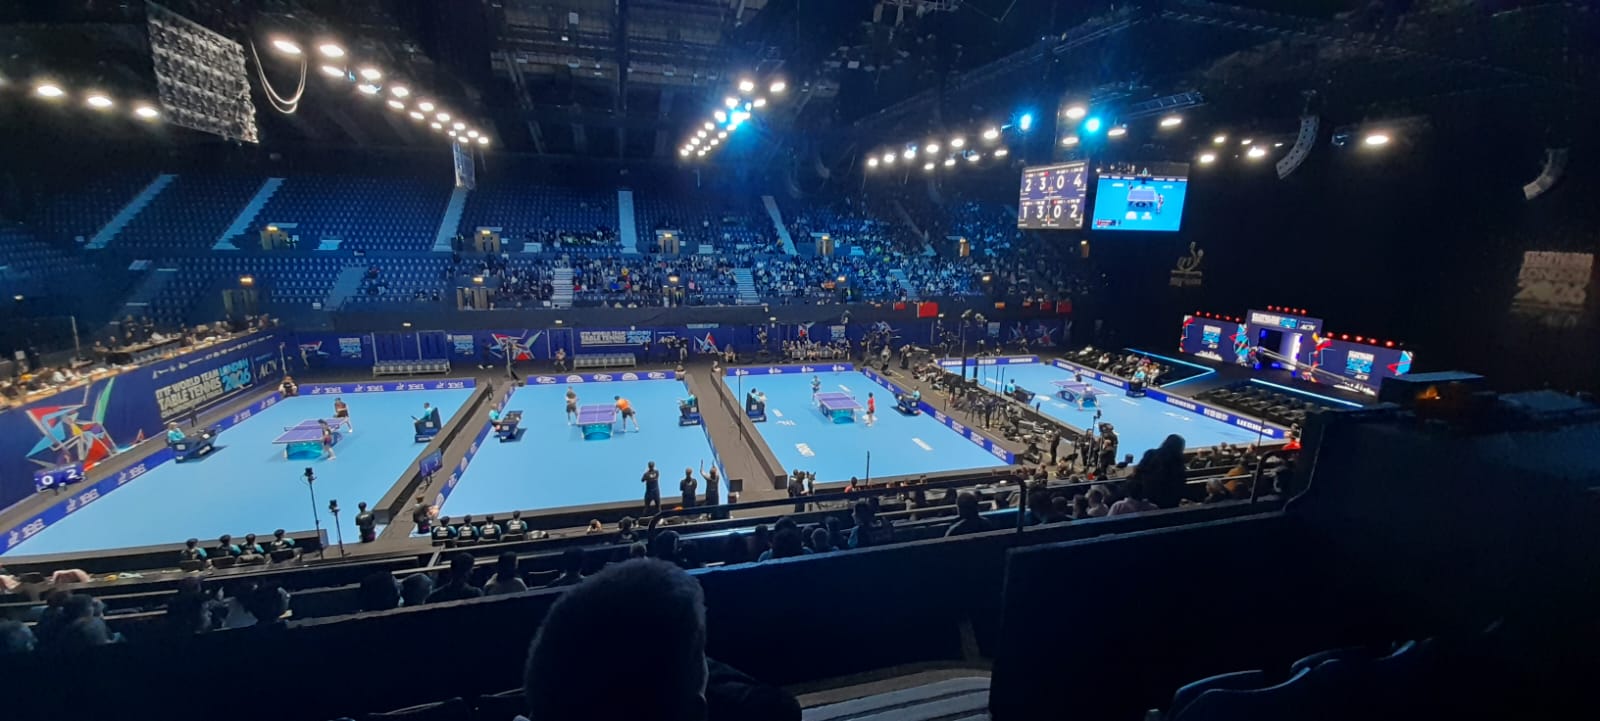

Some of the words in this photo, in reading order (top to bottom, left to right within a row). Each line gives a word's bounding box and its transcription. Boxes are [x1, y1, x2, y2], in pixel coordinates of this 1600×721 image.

[1025, 179, 1031, 192] 2
[1039, 177, 1046, 190] 3
[1057, 175, 1064, 189] 0
[1073, 173, 1082, 187] 4
[1023, 206, 1028, 218] 1
[1037, 205, 1043, 218] 3
[1053, 205, 1061, 218] 0
[1070, 204, 1078, 218] 2
[219, 358, 249, 376] LONDON
[171, 376, 200, 393] WORLD
[200, 369, 219, 381] TEAM
[222, 369, 252, 392] 2026
[158, 390, 190, 411] TABLE
[188, 377, 222, 400] TENNIS
[42, 475, 54, 485] 0
[66, 469, 77, 479] 2
